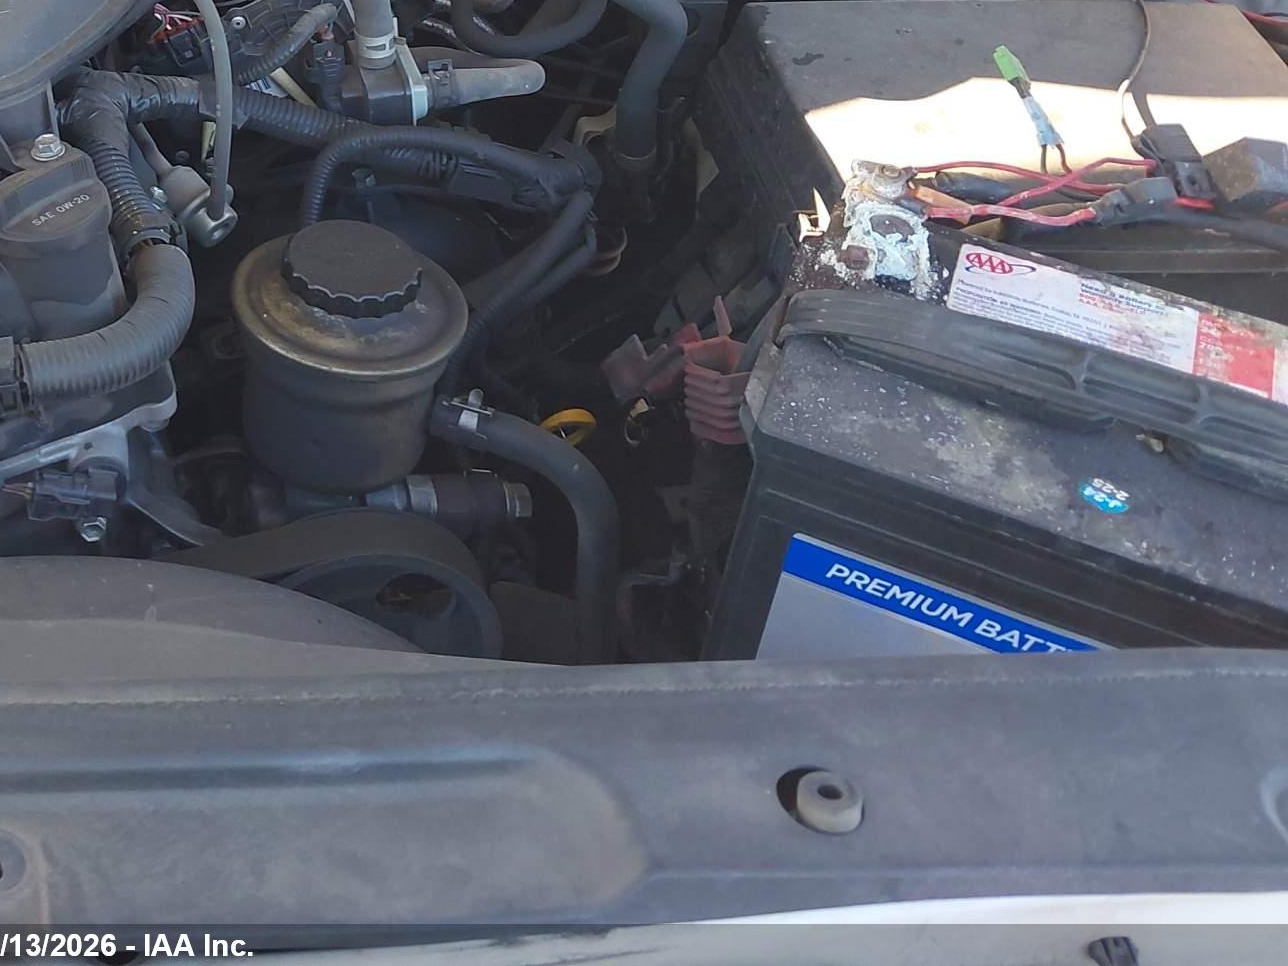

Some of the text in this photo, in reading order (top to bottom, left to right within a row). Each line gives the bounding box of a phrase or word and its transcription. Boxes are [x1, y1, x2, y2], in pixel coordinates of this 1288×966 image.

[31, 194, 90, 227] SAE 0W-20
[969, 251, 1012, 275] AAA
[825, 563, 1072, 655] PREMIUM BATT
